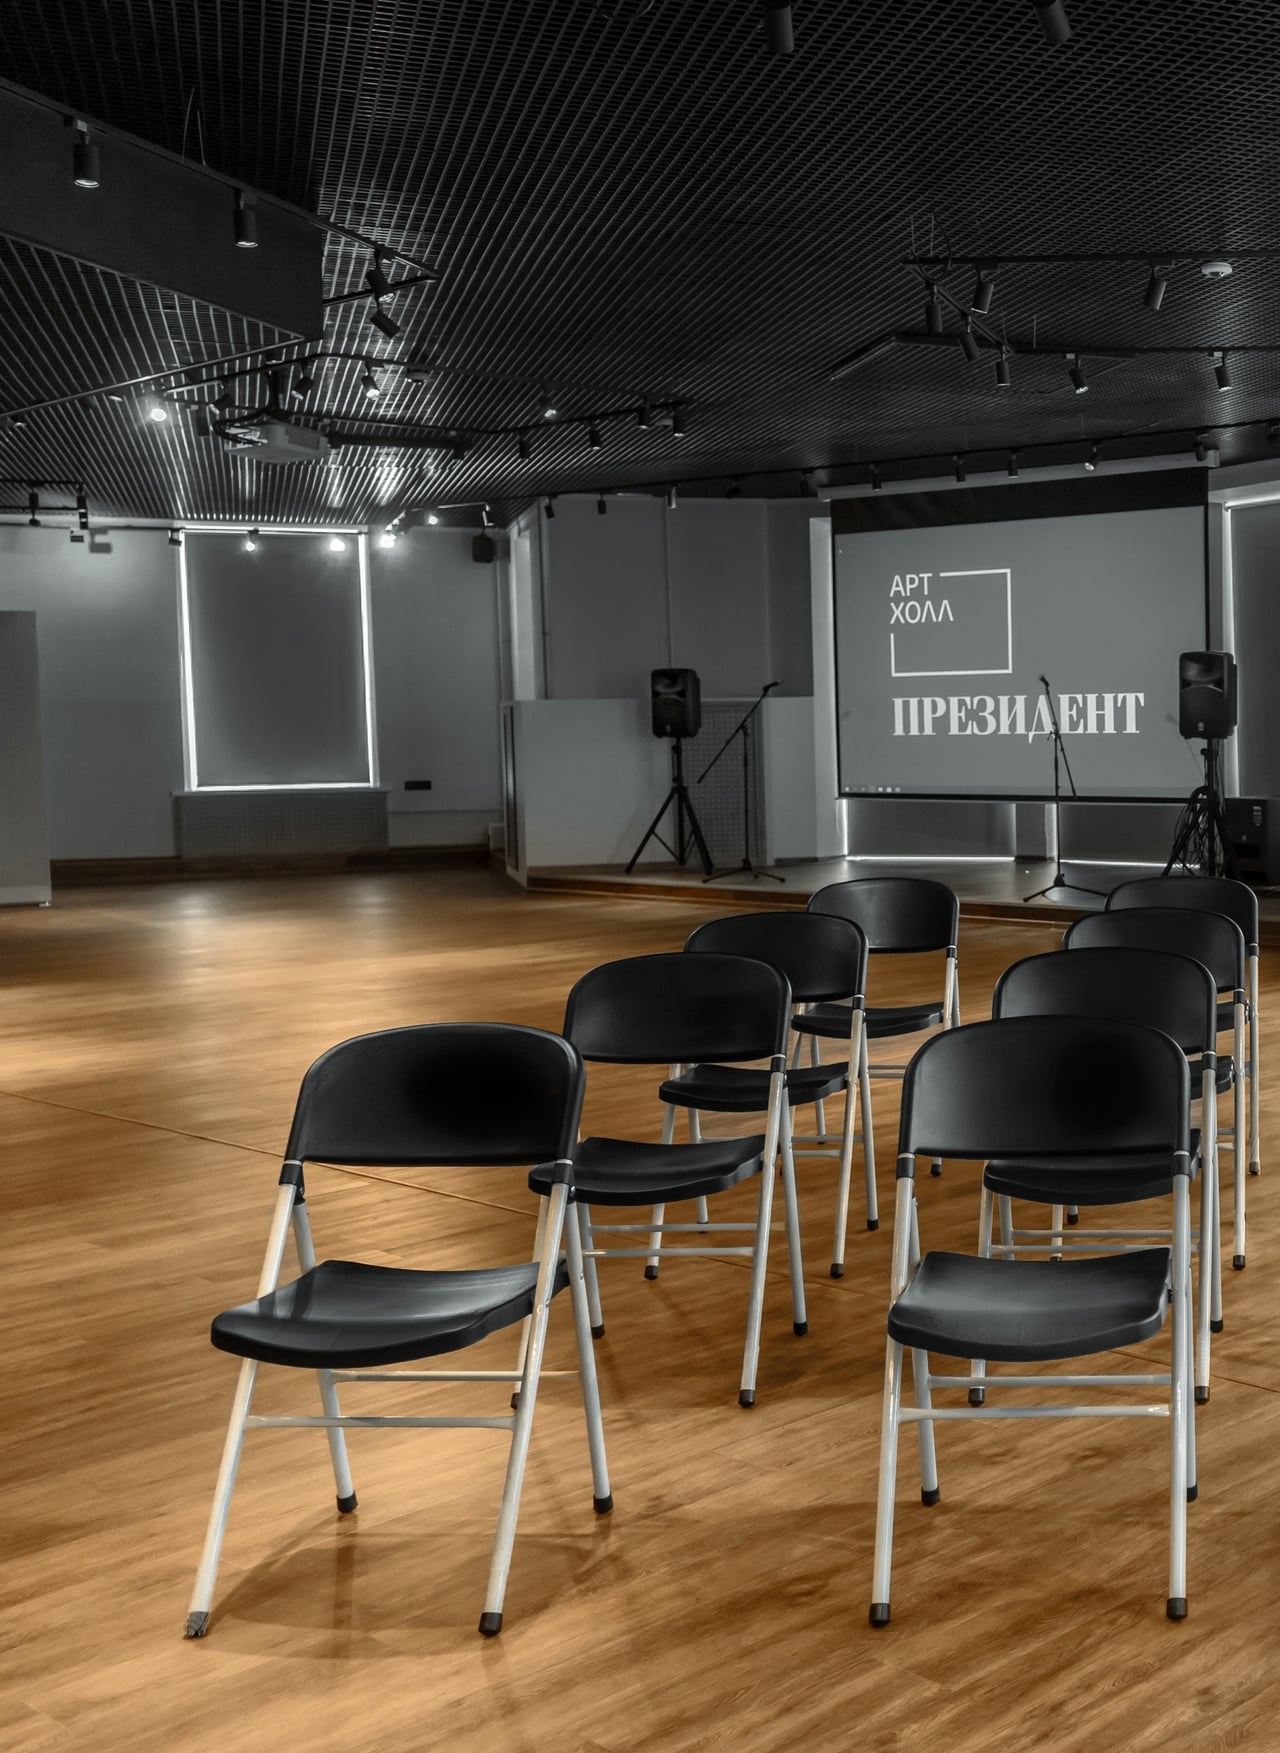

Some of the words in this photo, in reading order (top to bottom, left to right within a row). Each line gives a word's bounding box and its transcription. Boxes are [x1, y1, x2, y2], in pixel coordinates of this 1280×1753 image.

[890, 573, 933, 597] АРТ
[890, 600, 954, 624] ХОЛЛ
[892, 693, 1145, 743] ПРЕЗИДЕНТ
